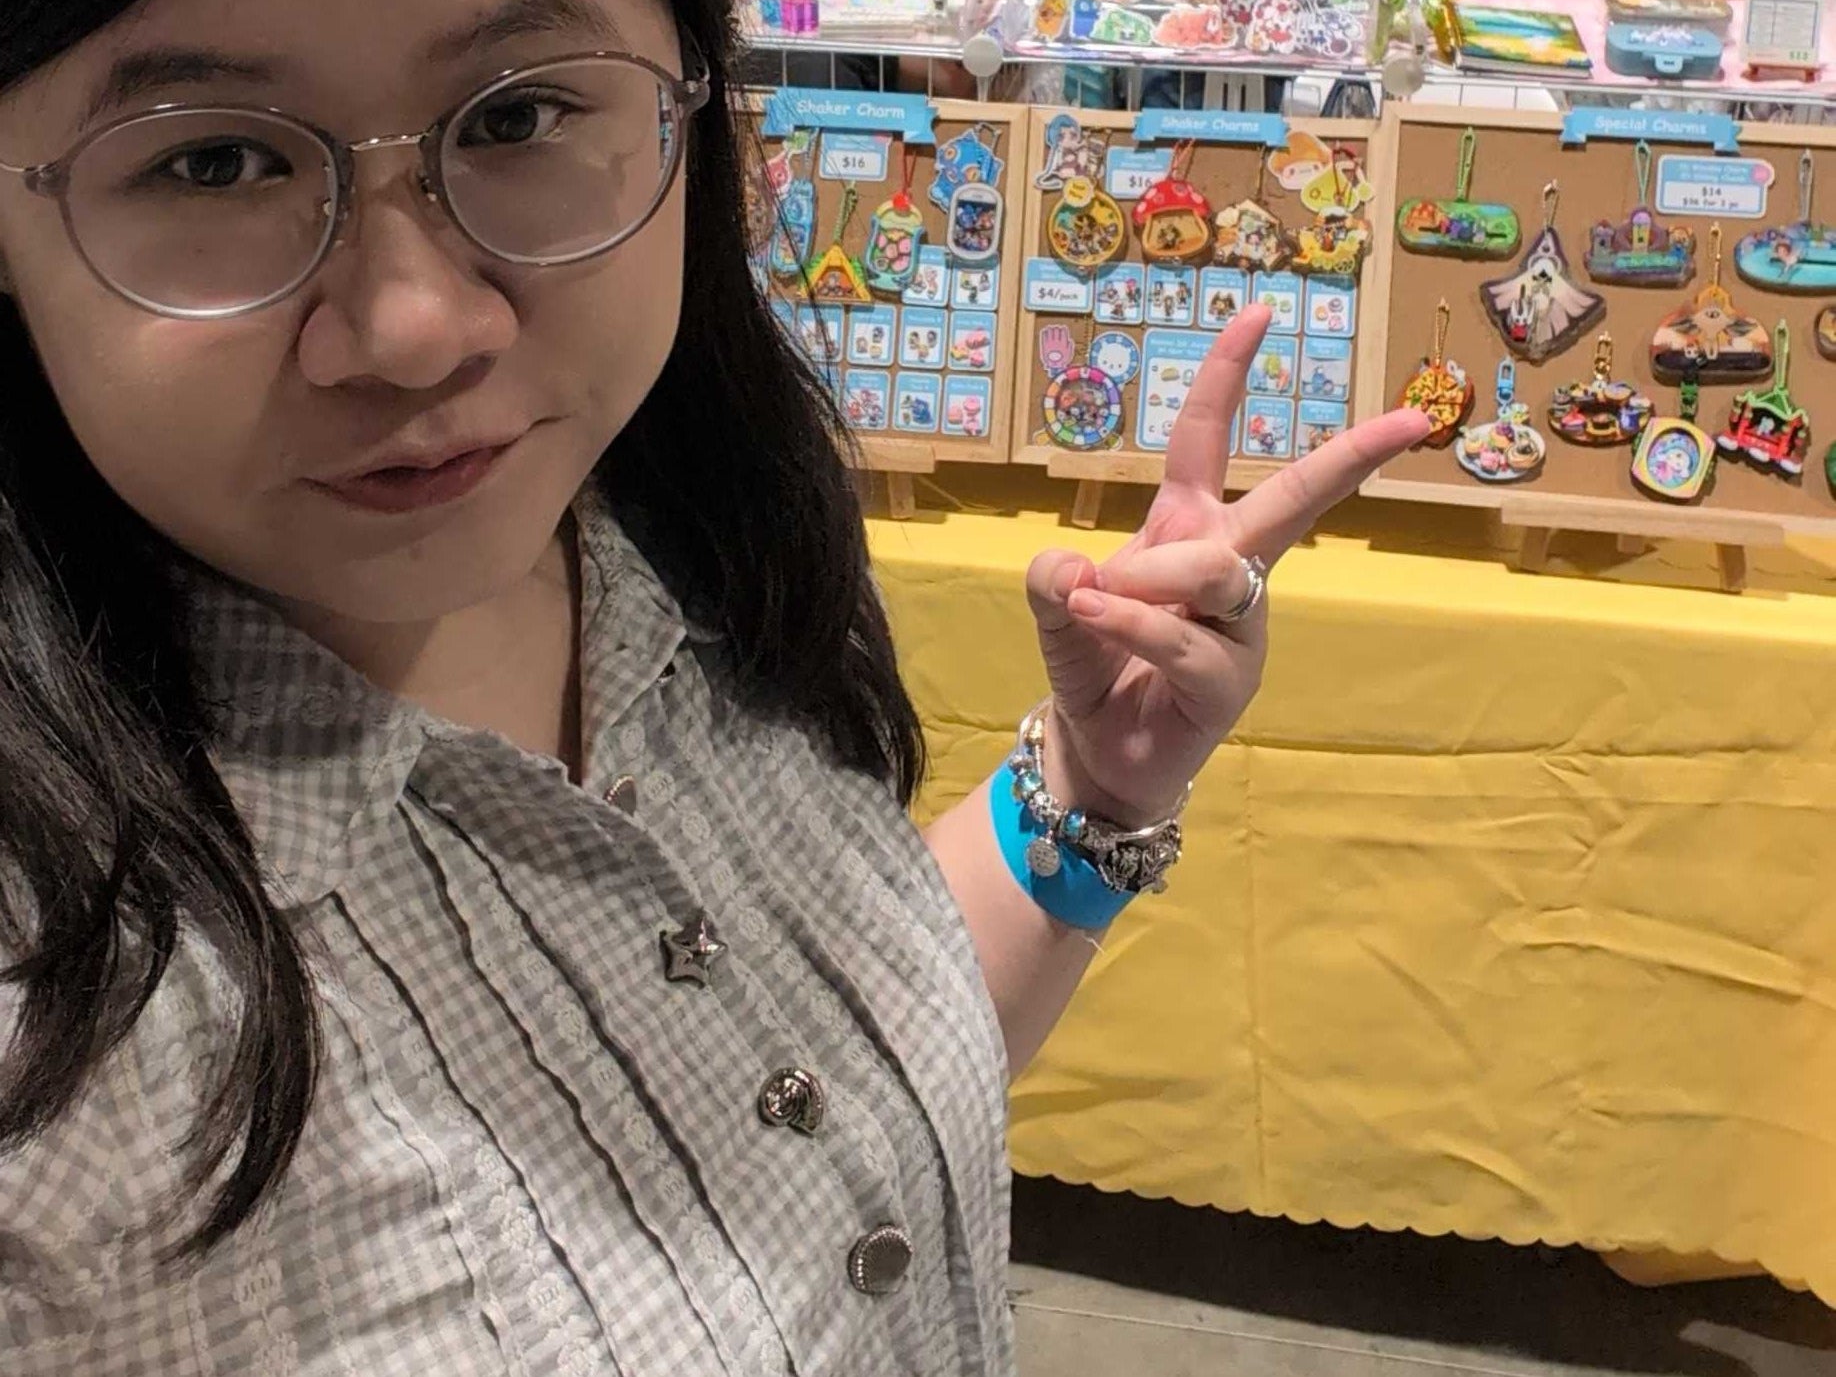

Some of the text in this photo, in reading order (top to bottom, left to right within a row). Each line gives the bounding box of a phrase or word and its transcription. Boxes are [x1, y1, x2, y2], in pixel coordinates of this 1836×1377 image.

[796, 99, 906, 119] Shaker Charm
[1161, 116, 1260, 133] Shaker Charms
[1594, 115, 1708, 135] Special Charms
[842, 156, 866, 170] $16
